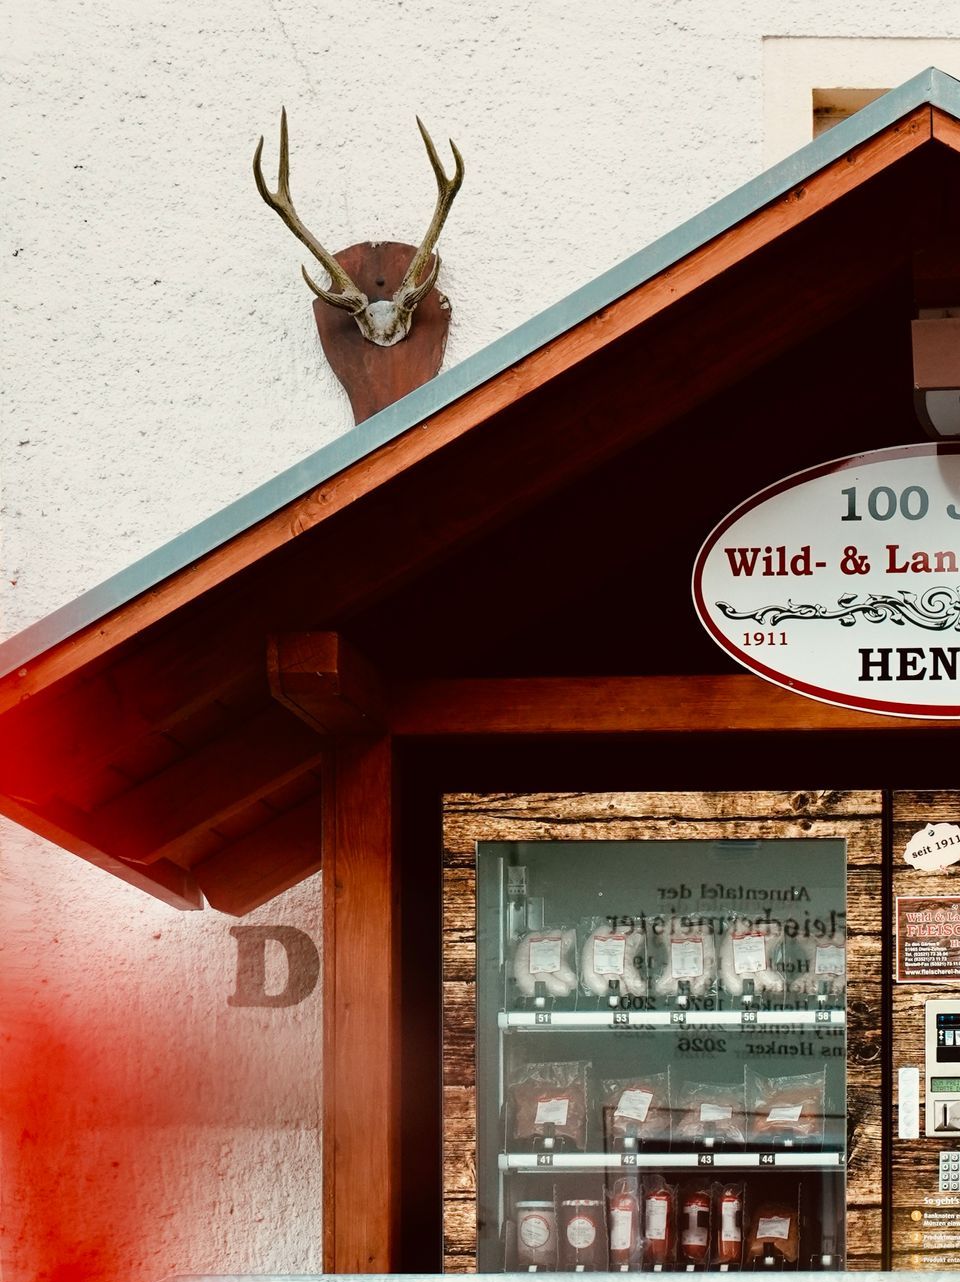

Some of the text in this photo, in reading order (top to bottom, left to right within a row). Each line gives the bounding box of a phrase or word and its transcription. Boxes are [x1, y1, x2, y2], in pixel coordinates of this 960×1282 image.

[840, 486, 929, 521] 100
[725, 546, 826, 577] Wild-
[840, 546, 871, 576] &
[742, 632, 788, 646] 1911
[911, 846, 932, 859] seit
[538, 1014, 548, 1022] 51
[616, 1013, 627, 1022] 53
[673, 1013, 684, 1022] 54
[818, 1012, 829, 1020] 58
[701, 1155, 712, 1163] 43
[762, 1155, 773, 1163] 44
